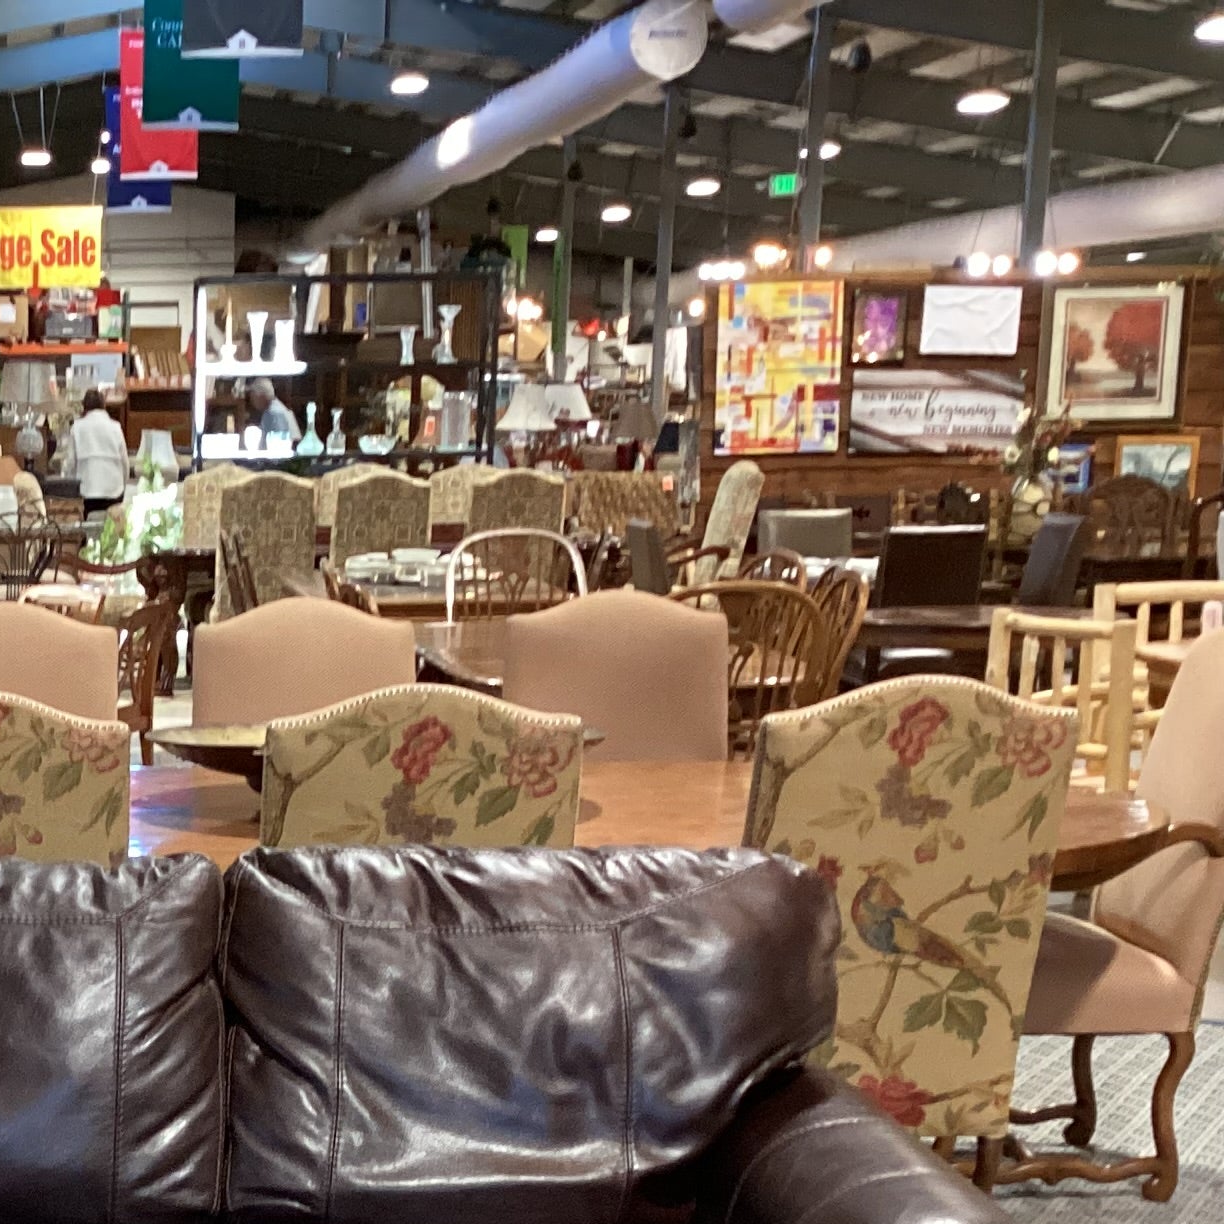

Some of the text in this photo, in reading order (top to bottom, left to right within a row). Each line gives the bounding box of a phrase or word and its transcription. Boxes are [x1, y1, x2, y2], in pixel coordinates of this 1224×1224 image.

[41, 229, 96, 268] Sale
[861, 391, 925, 401] NEW HOME
[889, 402, 920, 418] new
